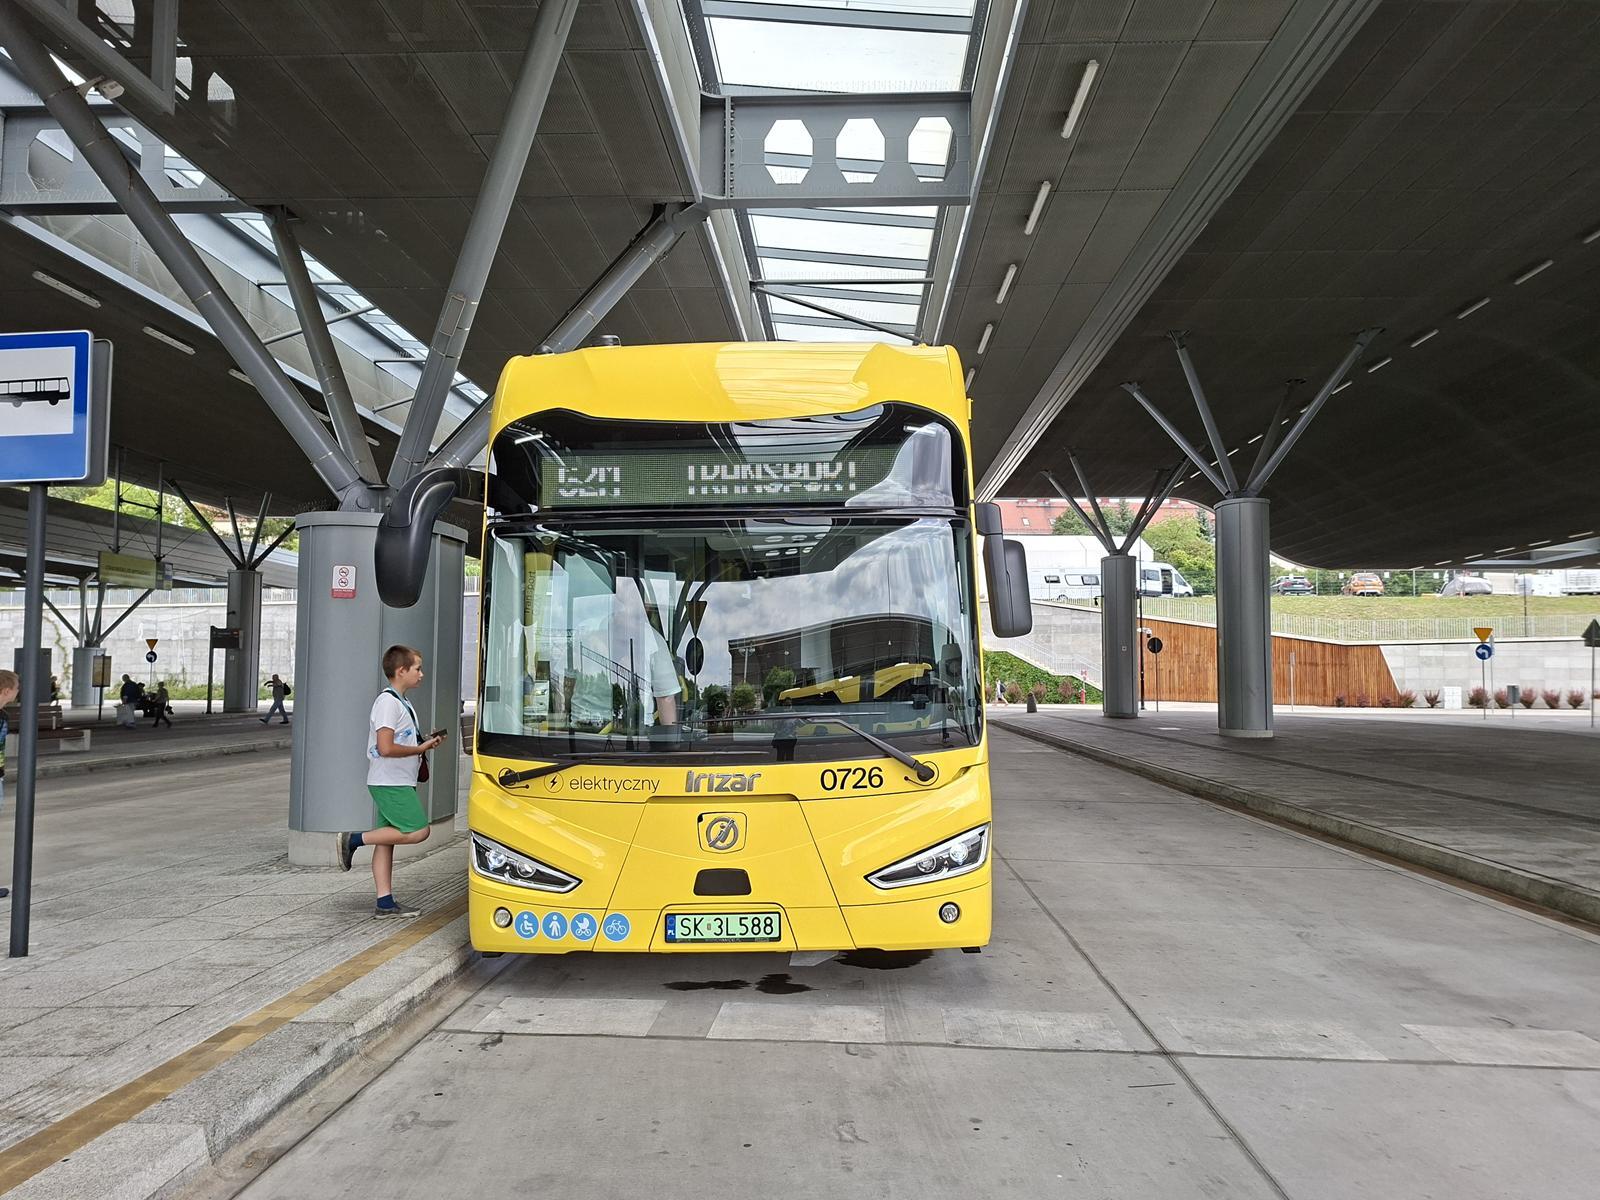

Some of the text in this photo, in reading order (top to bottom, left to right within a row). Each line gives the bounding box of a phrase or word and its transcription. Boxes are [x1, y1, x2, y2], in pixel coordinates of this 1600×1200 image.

[569, 776, 660, 793] elektryczny
[685, 770, 762, 793] Irizar
[820, 766, 884, 791] 0726
[680, 916, 774, 937] SK 3L588
